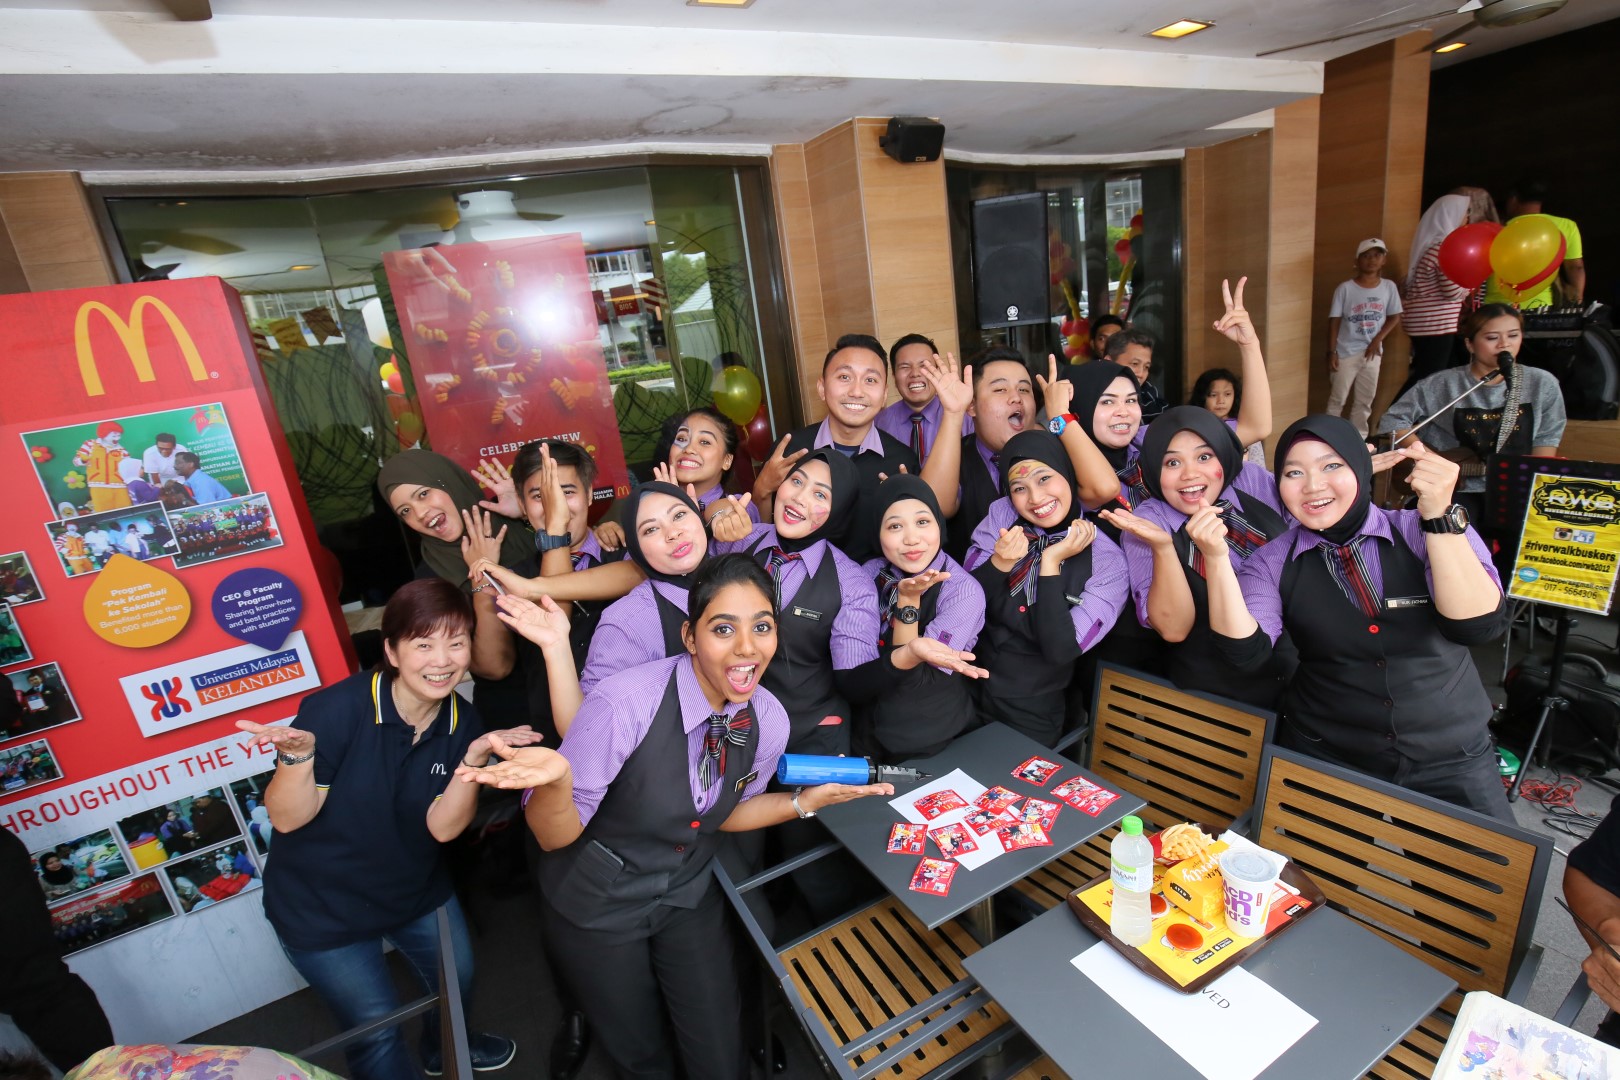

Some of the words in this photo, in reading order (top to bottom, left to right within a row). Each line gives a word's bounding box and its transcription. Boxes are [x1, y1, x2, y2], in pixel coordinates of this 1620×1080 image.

[1544, 507, 1583, 516] RIVERWALK
[1583, 510, 1614, 520] BUSKERS
[1525, 541, 1616, 562] #riverwalkbuskers
[110, 583, 152, 596] Program
[128, 588, 167, 602] Kembali
[222, 592, 242, 602] CEO
[252, 582, 282, 594] Faculty
[1544, 582, 1557, 592] 017
[225, 608, 255, 620] Sharing
[255, 598, 292, 612] know-how
[238, 594, 274, 607] Program
[100, 614, 141, 628] Benefited
[142, 610, 164, 618] more
[165, 604, 183, 612] than
[142, 615, 176, 627] students
[229, 620, 243, 629] and
[244, 615, 261, 624] best
[262, 606, 296, 620] practices
[241, 625, 257, 634] with
[258, 616, 290, 629] students
[196, 664, 248, 686] Universiti
[250, 654, 296, 672] Malaysia
[201, 665, 301, 702] KELANTAN
[1, 764, 171, 834] HROUGHOUT
[178, 747, 234, 777] THE
